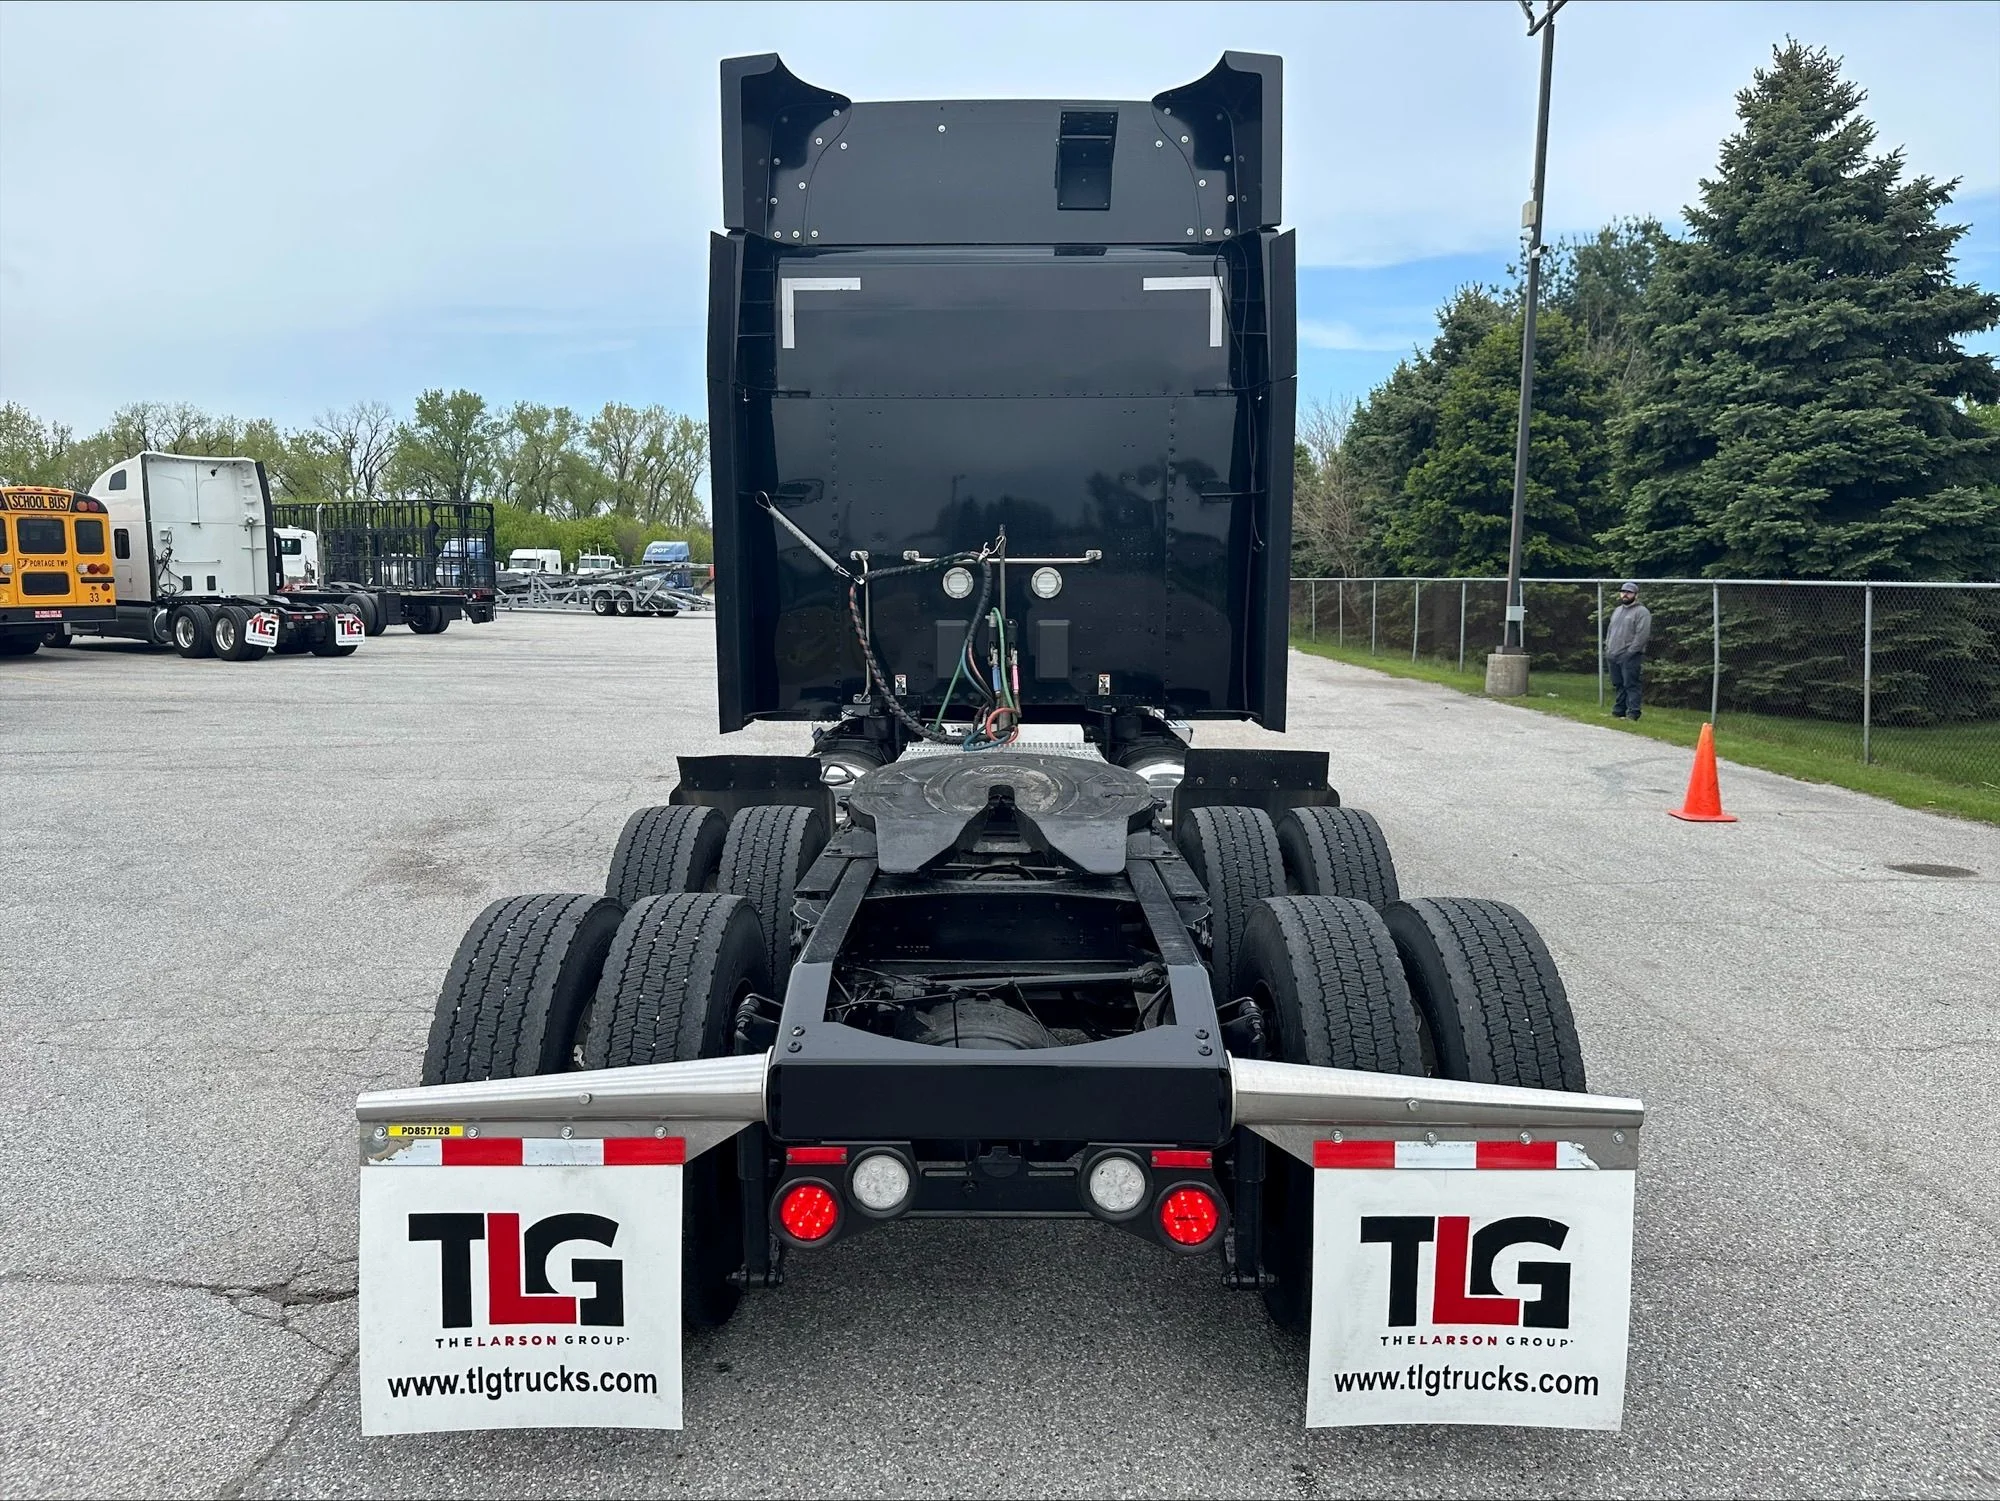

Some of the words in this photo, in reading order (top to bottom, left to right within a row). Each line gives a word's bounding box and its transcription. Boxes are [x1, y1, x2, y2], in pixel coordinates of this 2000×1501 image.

[12, 495, 47, 509] SCHOOL
[48, 496, 66, 508] BUS
[89, 592, 99, 602] 33
[401, 1126, 450, 1135] PD857128
[408, 1212, 624, 1328] TLG
[1360, 1215, 1572, 1329] TLG
[387, 1364, 657, 1401] www.tlgtrucks.com
[1334, 1363, 1599, 1397] www.tlgtrucks.com
